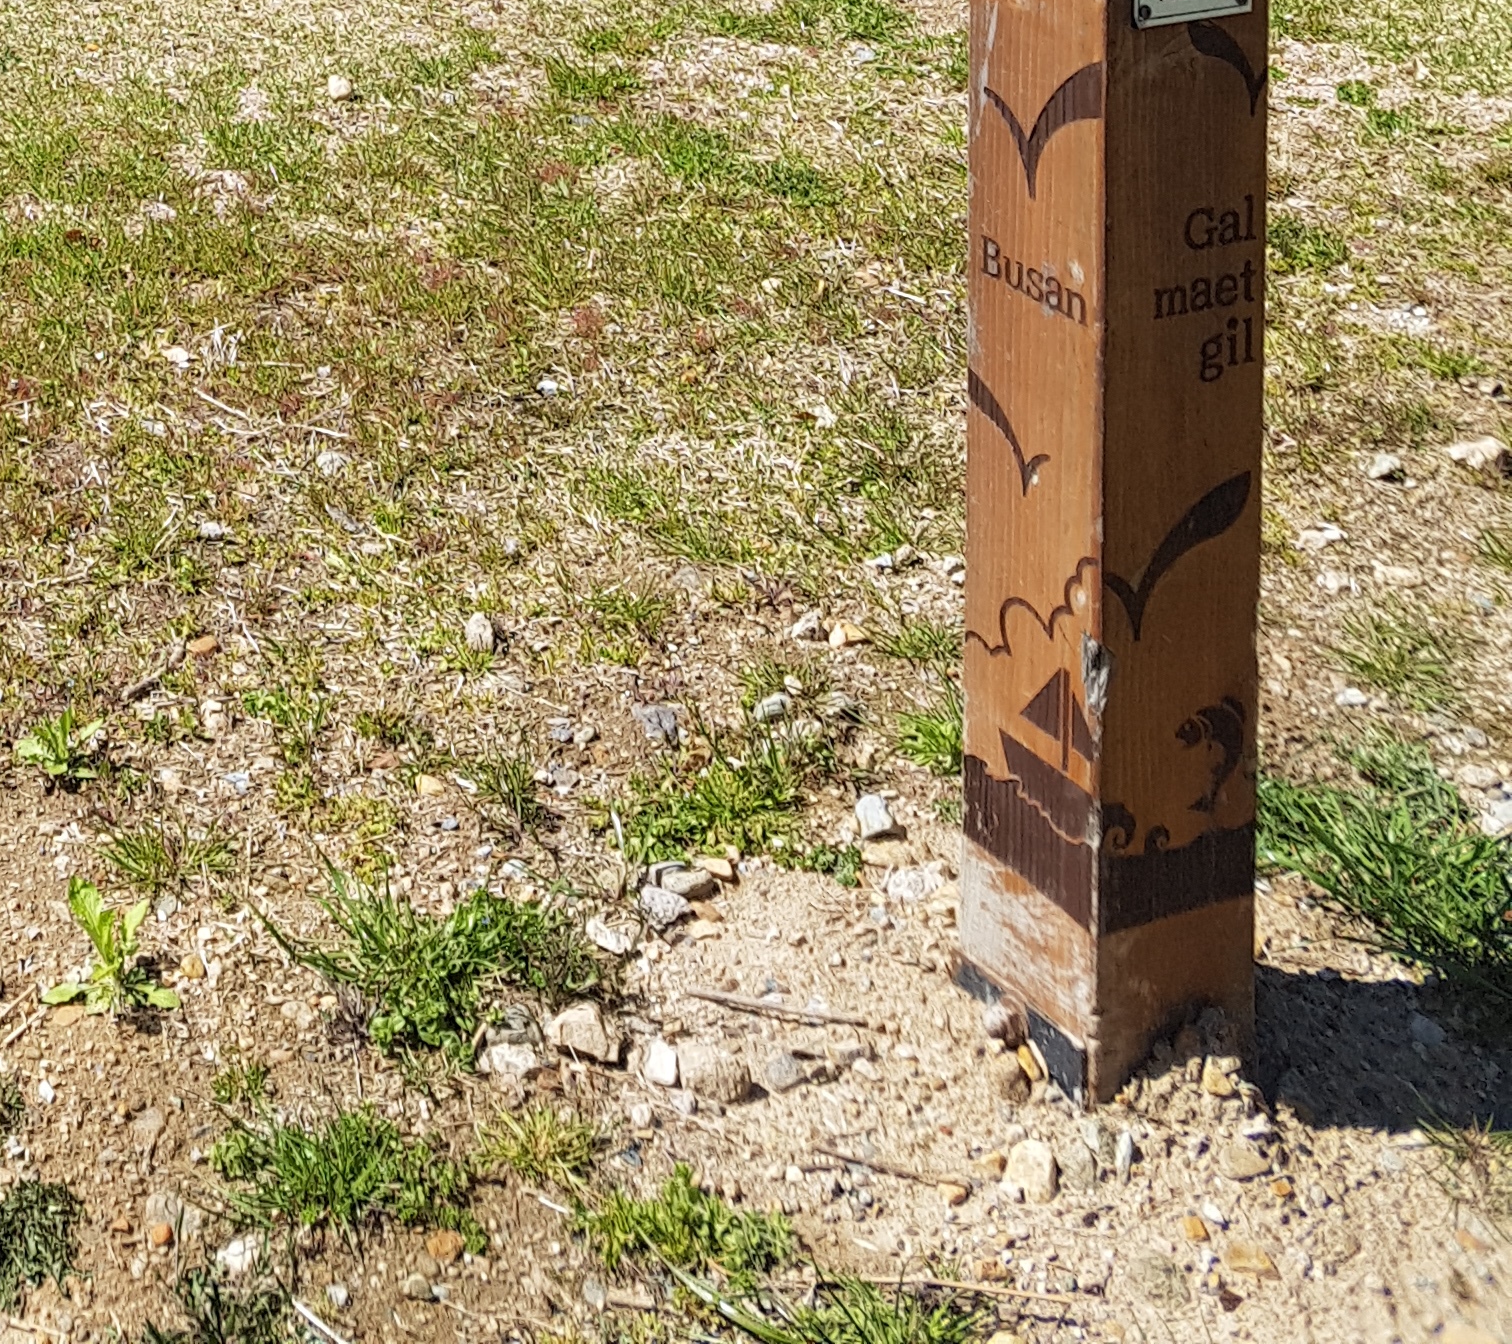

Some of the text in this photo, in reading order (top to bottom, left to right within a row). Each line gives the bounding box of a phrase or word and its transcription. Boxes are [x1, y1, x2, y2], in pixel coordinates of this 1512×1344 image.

[1184, 194, 1257, 250] Gal
[980, 234, 1088, 327] Busan
[1153, 259, 1257, 320] maet
[1199, 316, 1254, 383] gil
